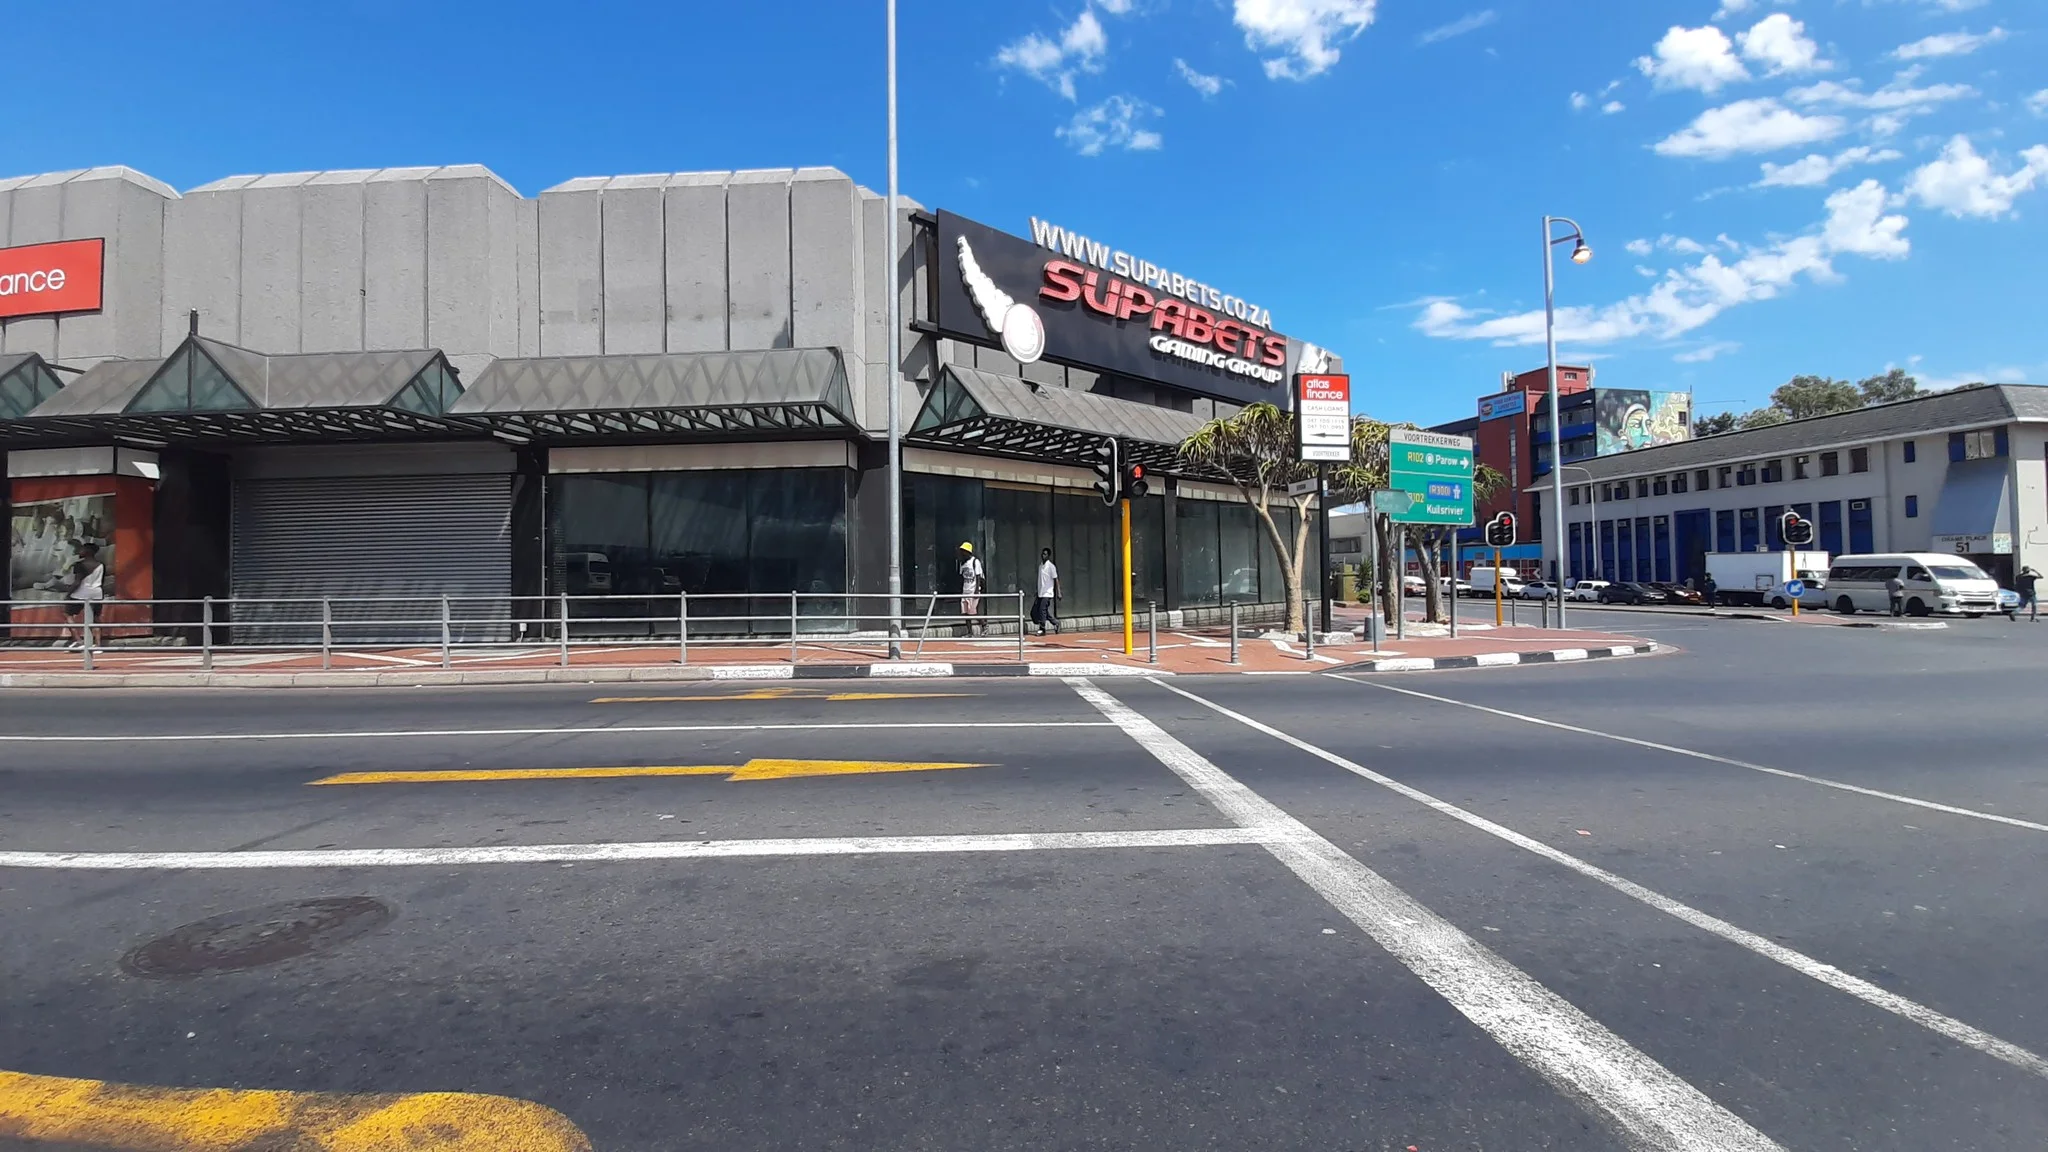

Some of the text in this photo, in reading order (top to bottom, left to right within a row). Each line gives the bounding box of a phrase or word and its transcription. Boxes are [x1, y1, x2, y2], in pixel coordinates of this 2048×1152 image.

[1029, 216, 1272, 330] WWW.SUPABETS.CO.ZA
[1039, 259, 1288, 367] SUPABETS
[1150, 335, 1283, 384] GAMING GROUP
[1306, 379, 1330, 389] atlas
[1306, 389, 1343, 400] finance
[1404, 433, 1461, 447] VOORTREKKERWEG
[1407, 451, 1458, 466] R102 Parow
[1426, 504, 1464, 516] Kuilsrivier
[1956, 541, 1970, 553] 51
